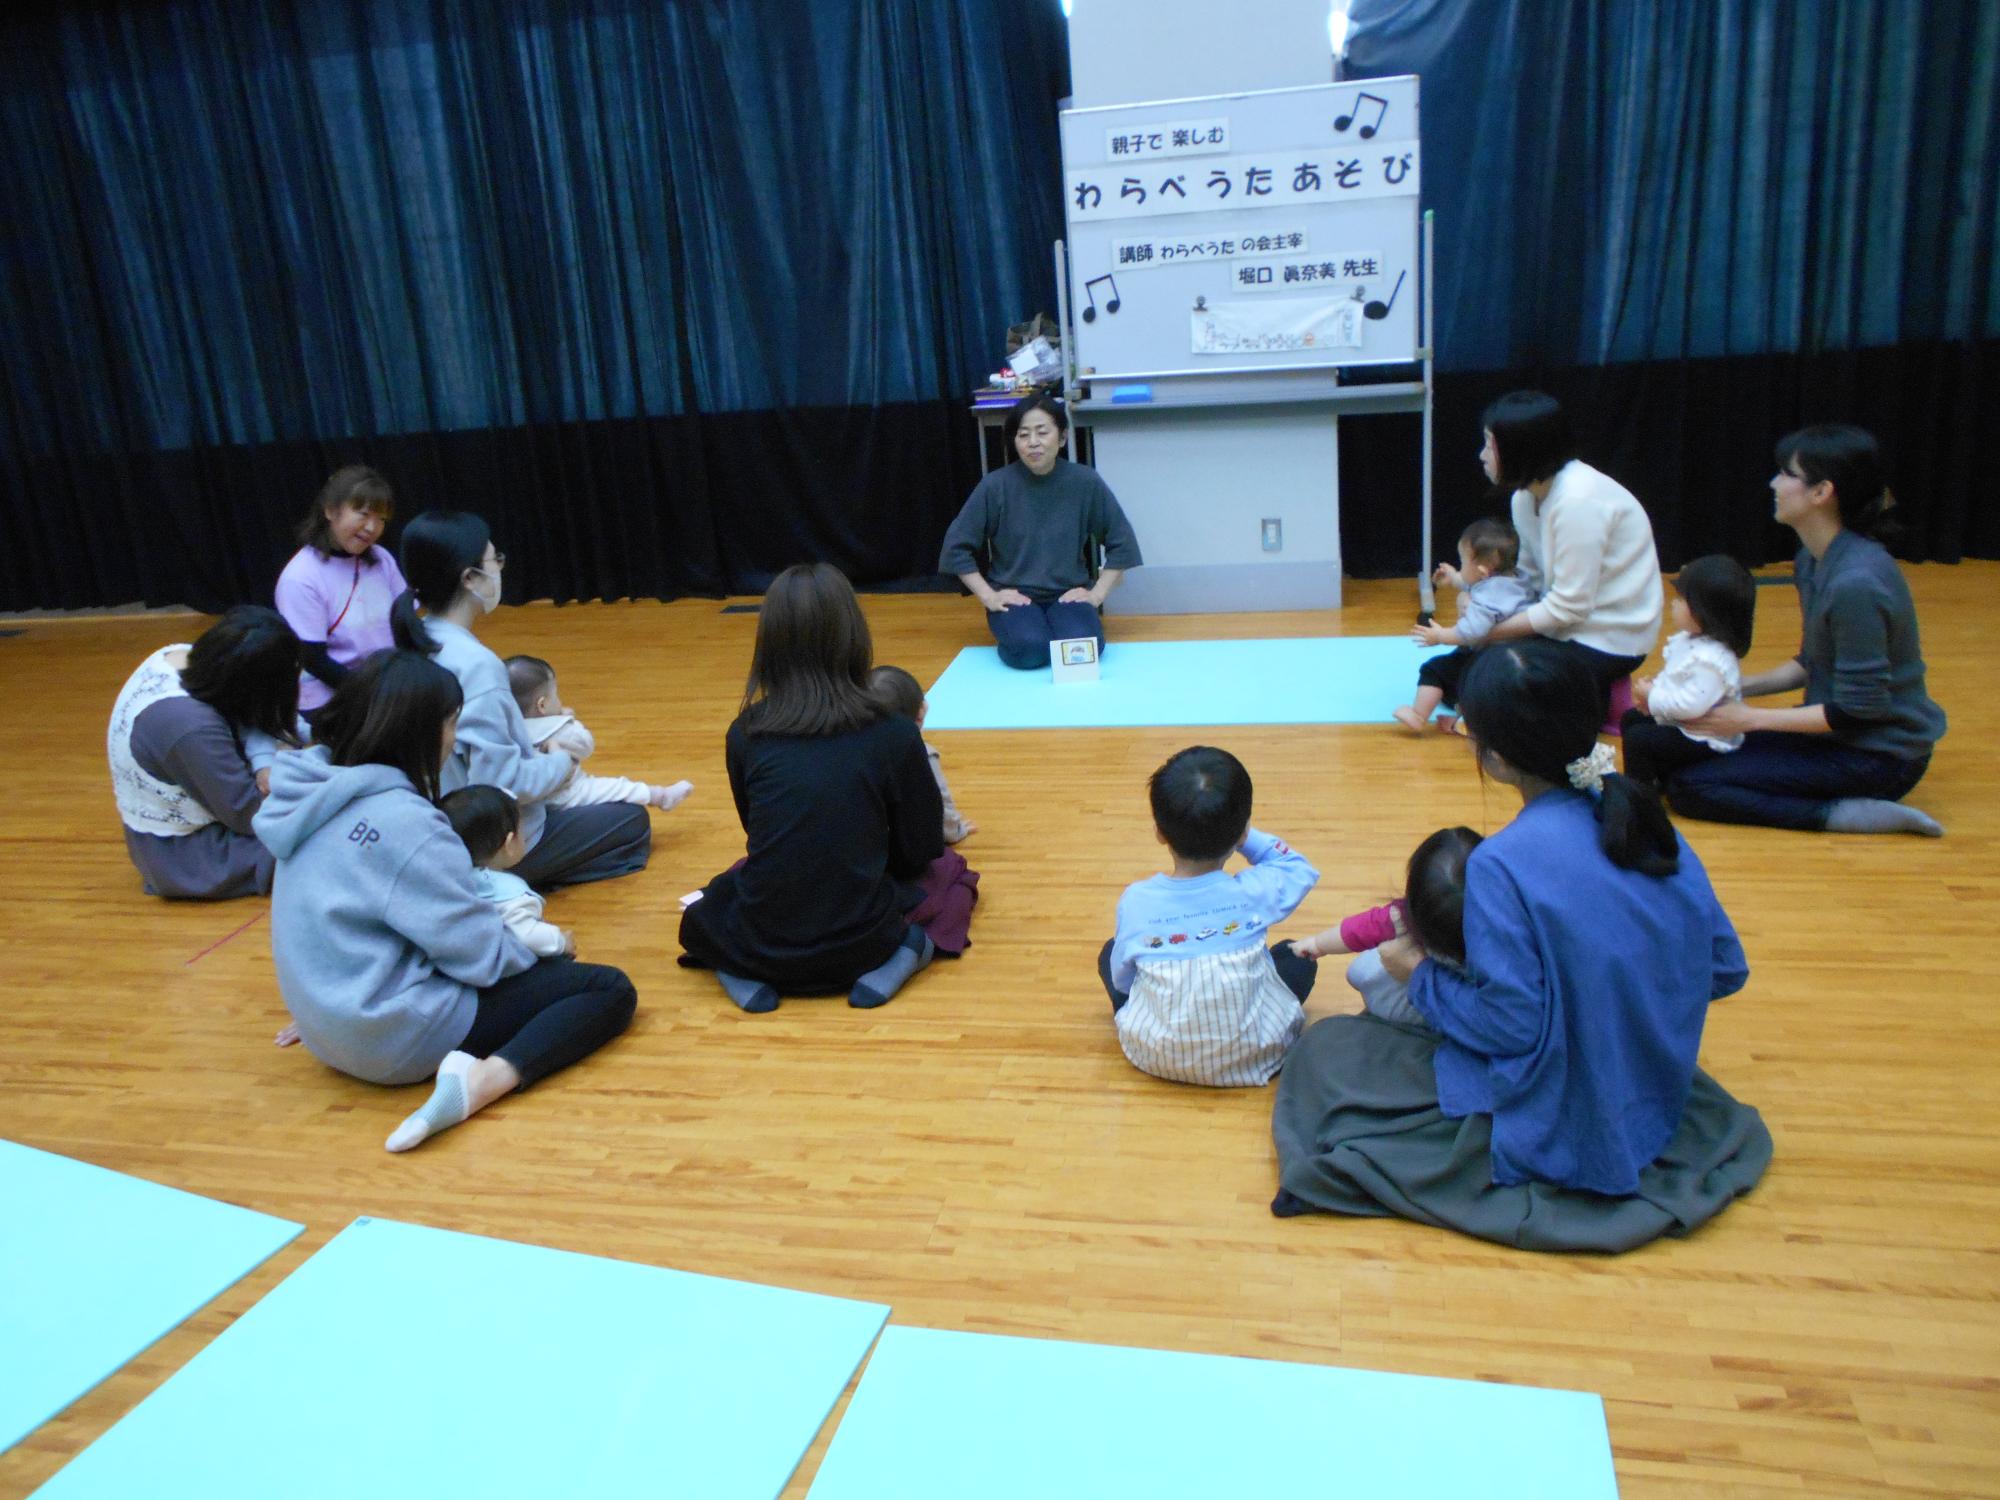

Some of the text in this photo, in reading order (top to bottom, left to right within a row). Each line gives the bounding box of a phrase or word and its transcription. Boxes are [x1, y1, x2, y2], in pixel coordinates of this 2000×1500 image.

[1112, 127, 1223, 154] 親子で 楽しむ
[1119, 232, 1302, 264] 講師 わらべうた の会主宰
[1239, 267, 1272, 284] 堀口
[1343, 259, 1378, 277] 先生
